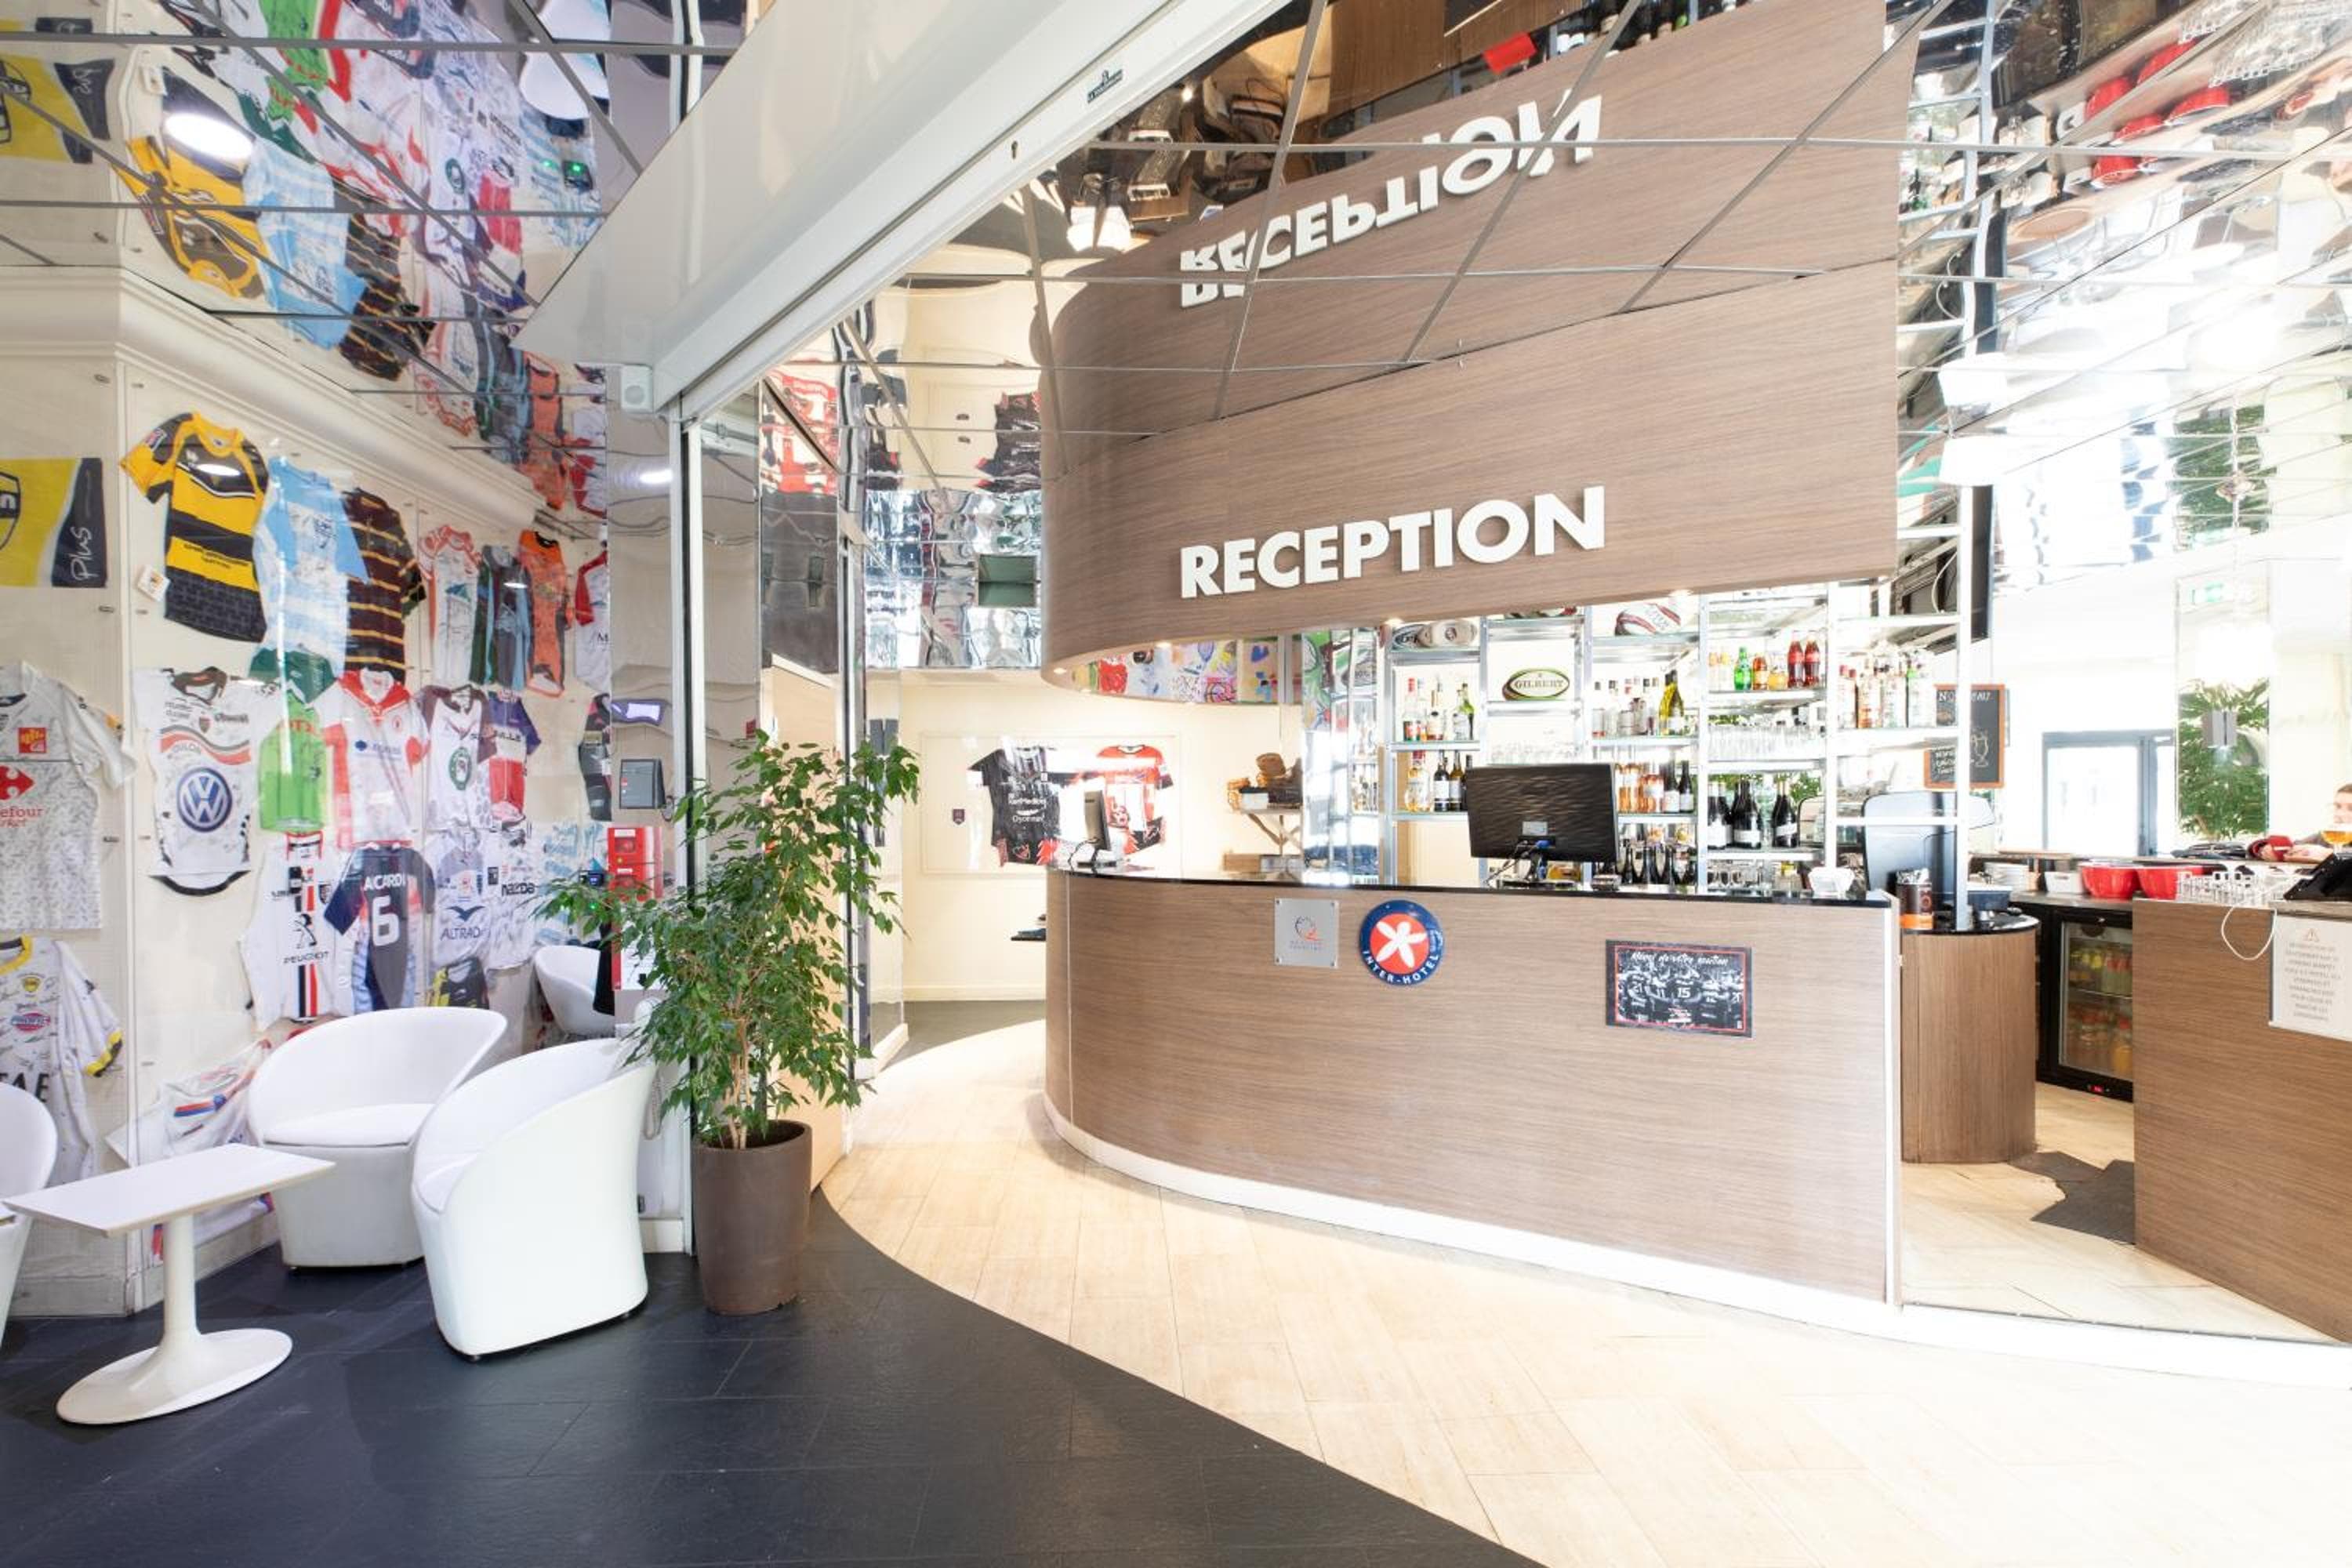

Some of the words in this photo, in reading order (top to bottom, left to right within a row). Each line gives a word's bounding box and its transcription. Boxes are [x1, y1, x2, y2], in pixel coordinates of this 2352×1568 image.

[1181, 485, 1605, 598] RECEPTION
[372, 894, 401, 946] 6
[440, 926, 481, 941] ALTRAD
[1362, 949, 1439, 983] INTER-HOTEL
[1677, 987, 1691, 998] 15
